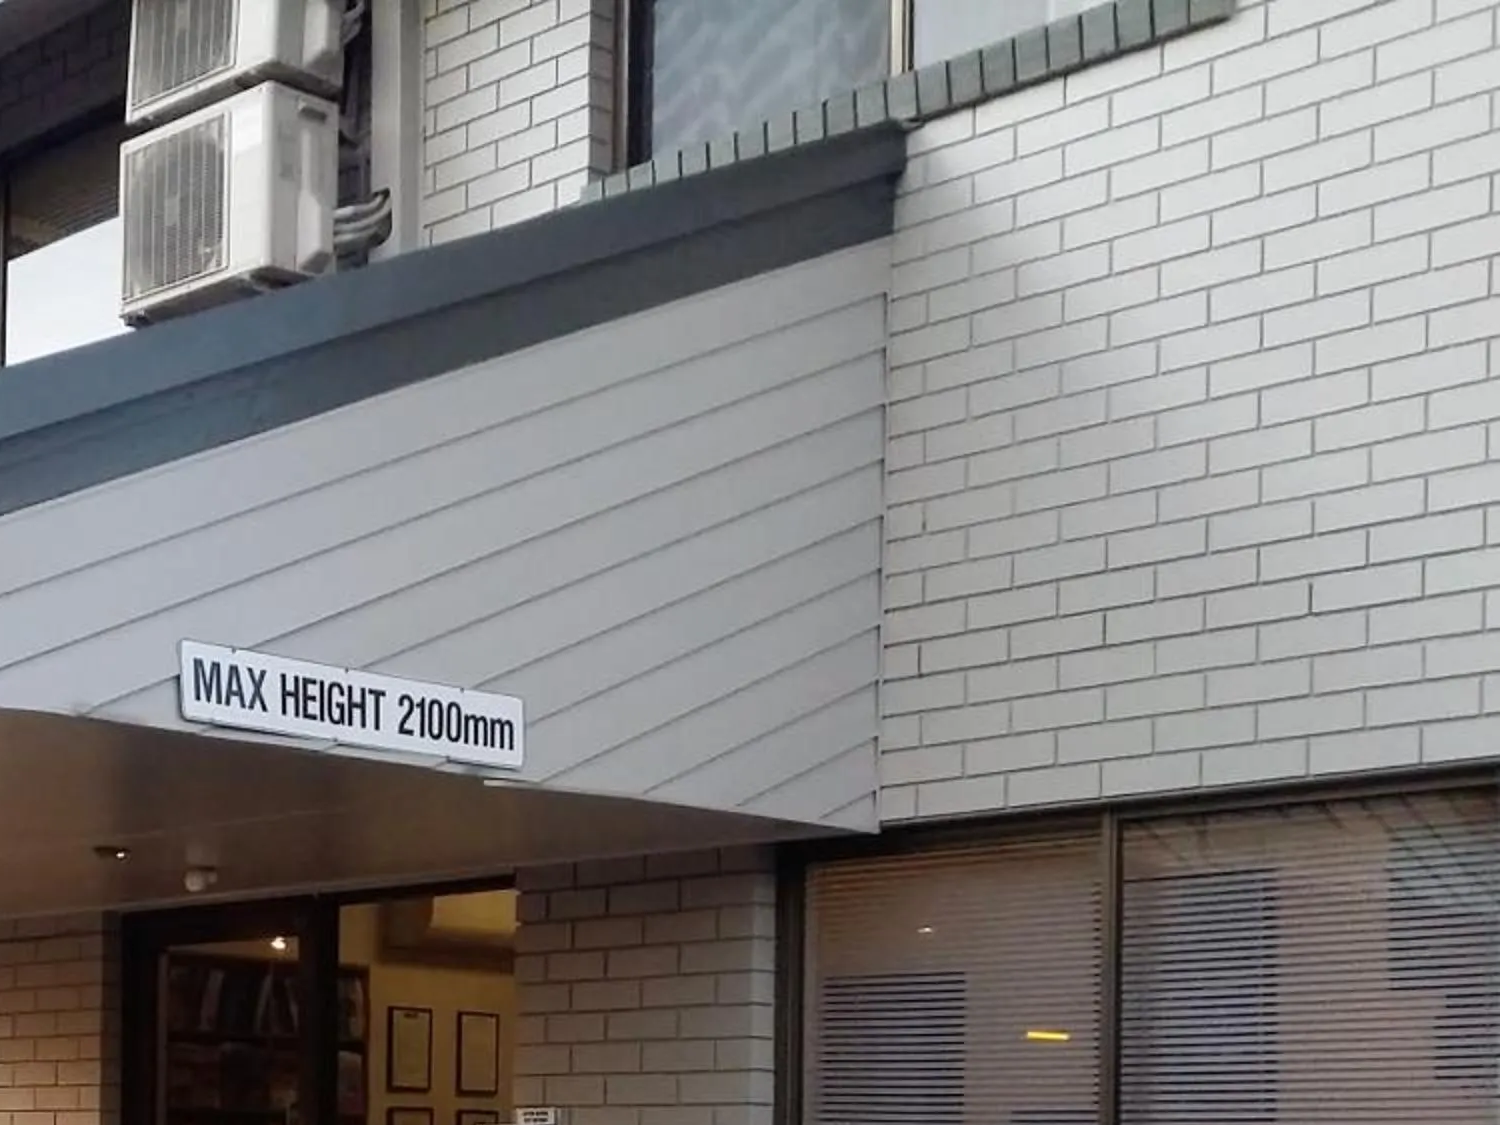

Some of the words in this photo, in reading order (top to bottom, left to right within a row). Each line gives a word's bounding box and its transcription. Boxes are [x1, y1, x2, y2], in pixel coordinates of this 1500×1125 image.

[192, 657, 268, 713] MAX
[280, 673, 387, 731] HEIGHT
[397, 693, 515, 751] 2100mm
